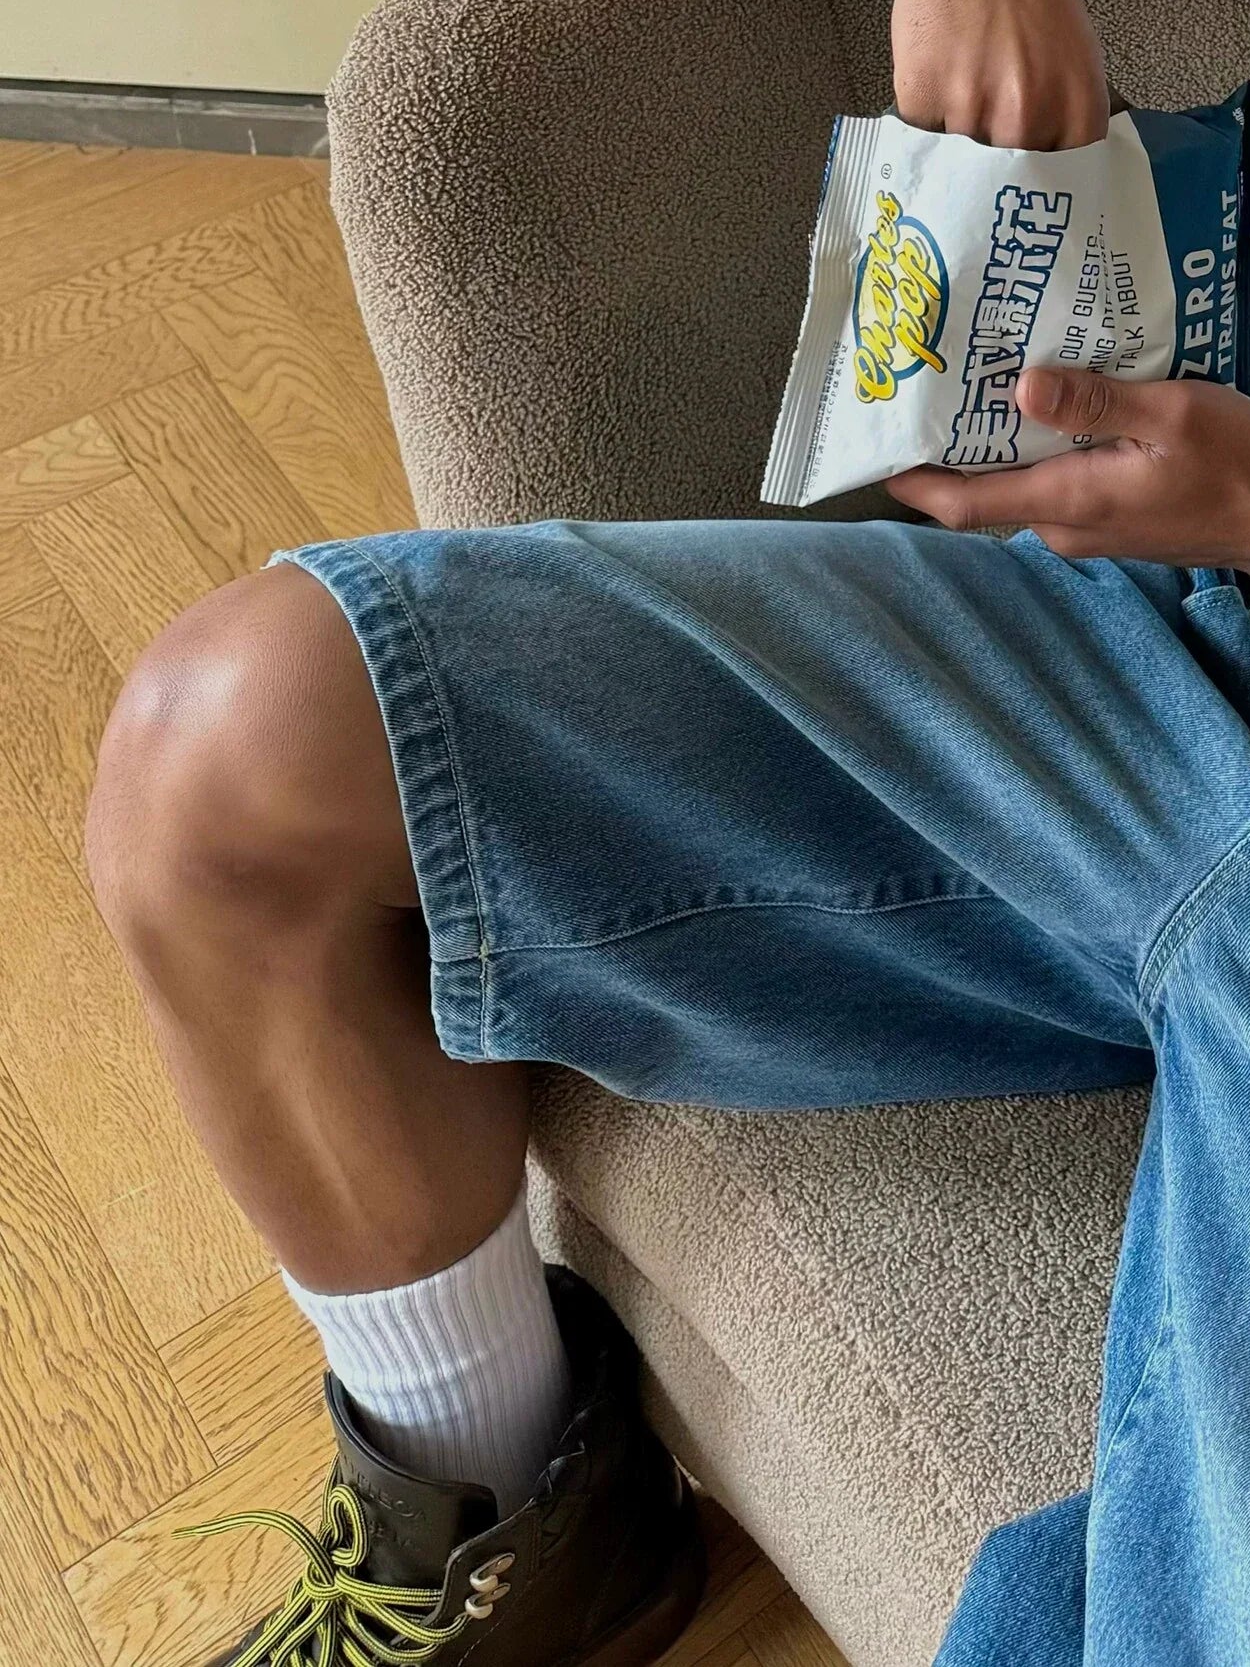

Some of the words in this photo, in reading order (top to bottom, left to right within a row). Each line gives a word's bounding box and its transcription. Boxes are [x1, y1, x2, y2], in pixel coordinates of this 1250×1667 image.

[1221, 190, 1239, 253] FAT
[854, 190, 903, 404] Charles
[896, 236, 948, 373] pop
[943, 184, 1073, 466] 美式爆米花
[1110, 249, 1141, 316] ABOUT
[1177, 248, 1216, 380] ZERO
[1217, 262, 1238, 374] TRANS
[1059, 325, 1088, 360] OUR
[1115, 325, 1145, 372] TALK
